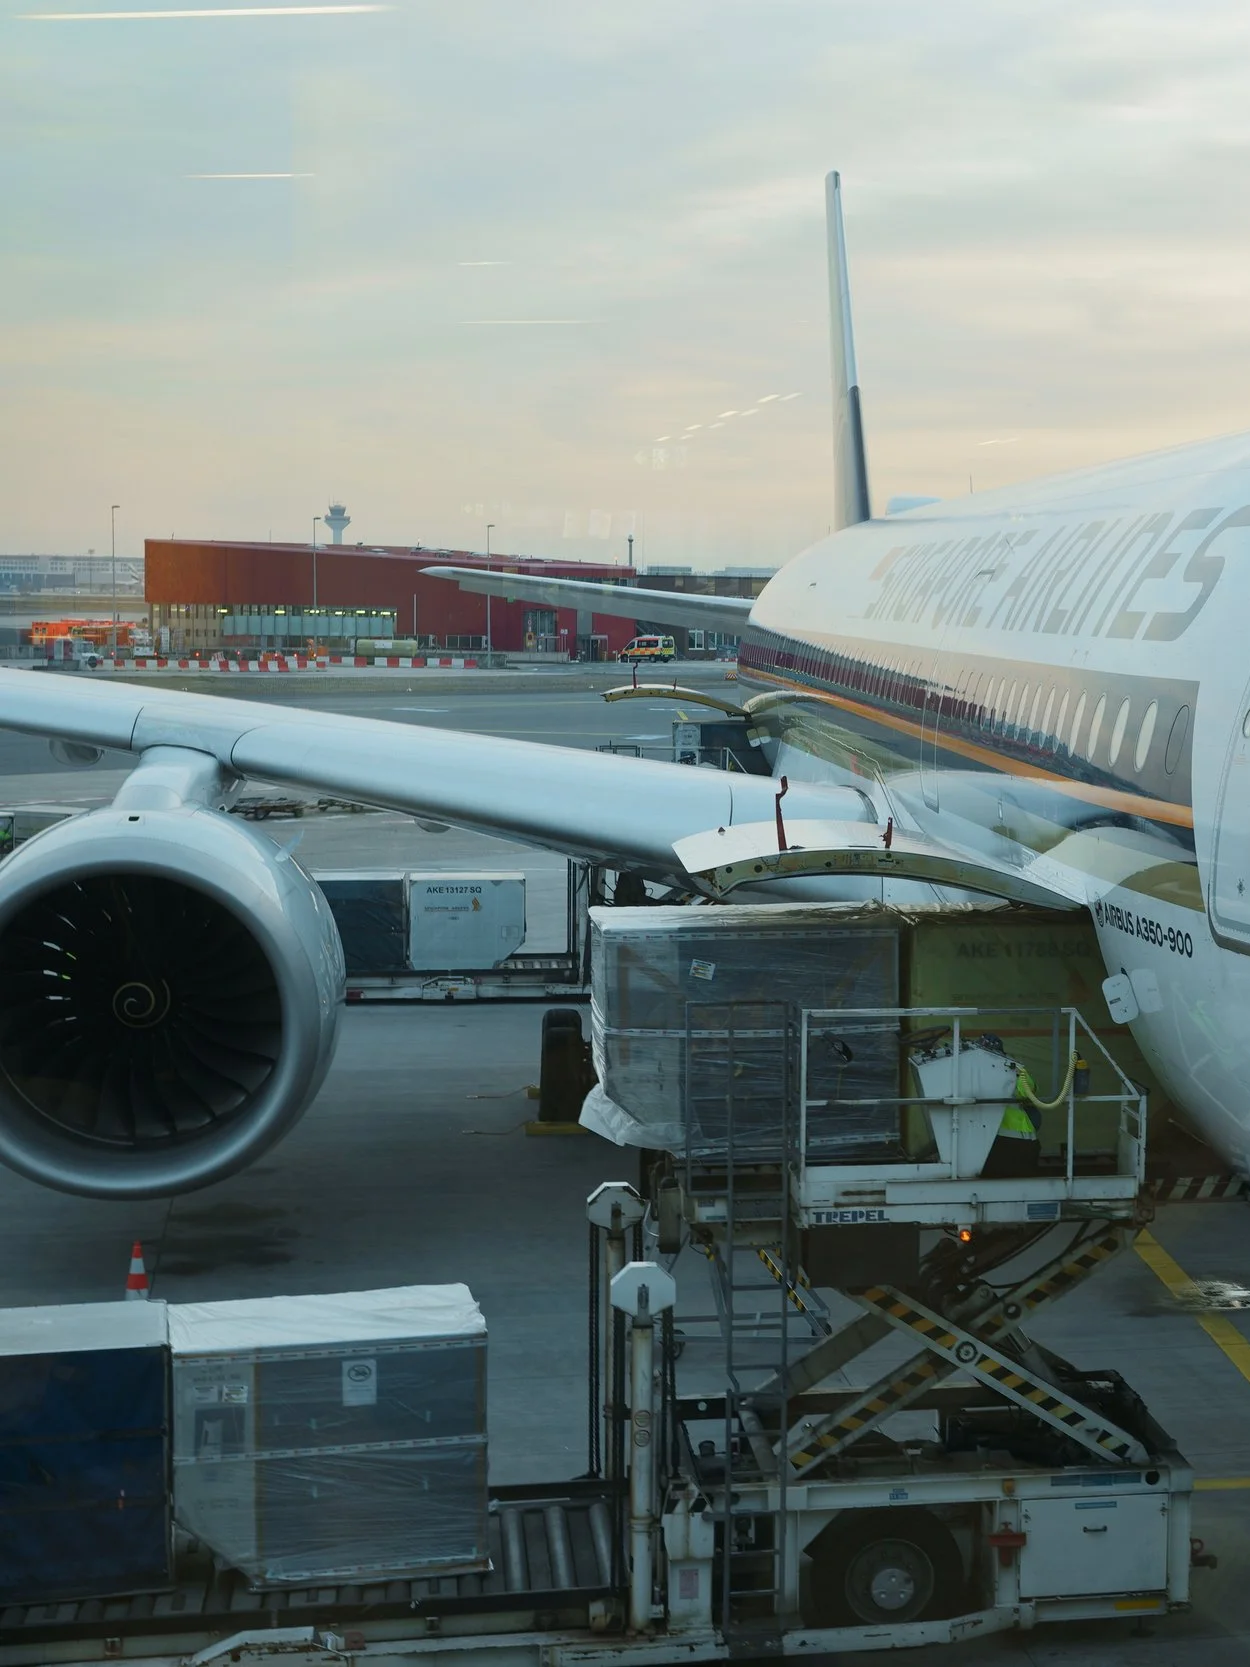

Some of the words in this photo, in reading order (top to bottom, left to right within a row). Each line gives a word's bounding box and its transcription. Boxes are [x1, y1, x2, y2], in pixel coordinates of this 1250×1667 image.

[426, 886, 444, 894] AKE
[446, 886, 467, 894] 13127
[470, 886, 482, 894] SQ
[1104, 902, 1135, 936] AIRBUS
[1136, 915, 1194, 959] A350-900
[957, 941, 998, 958] AKE
[812, 1209, 890, 1224] TREPEL
